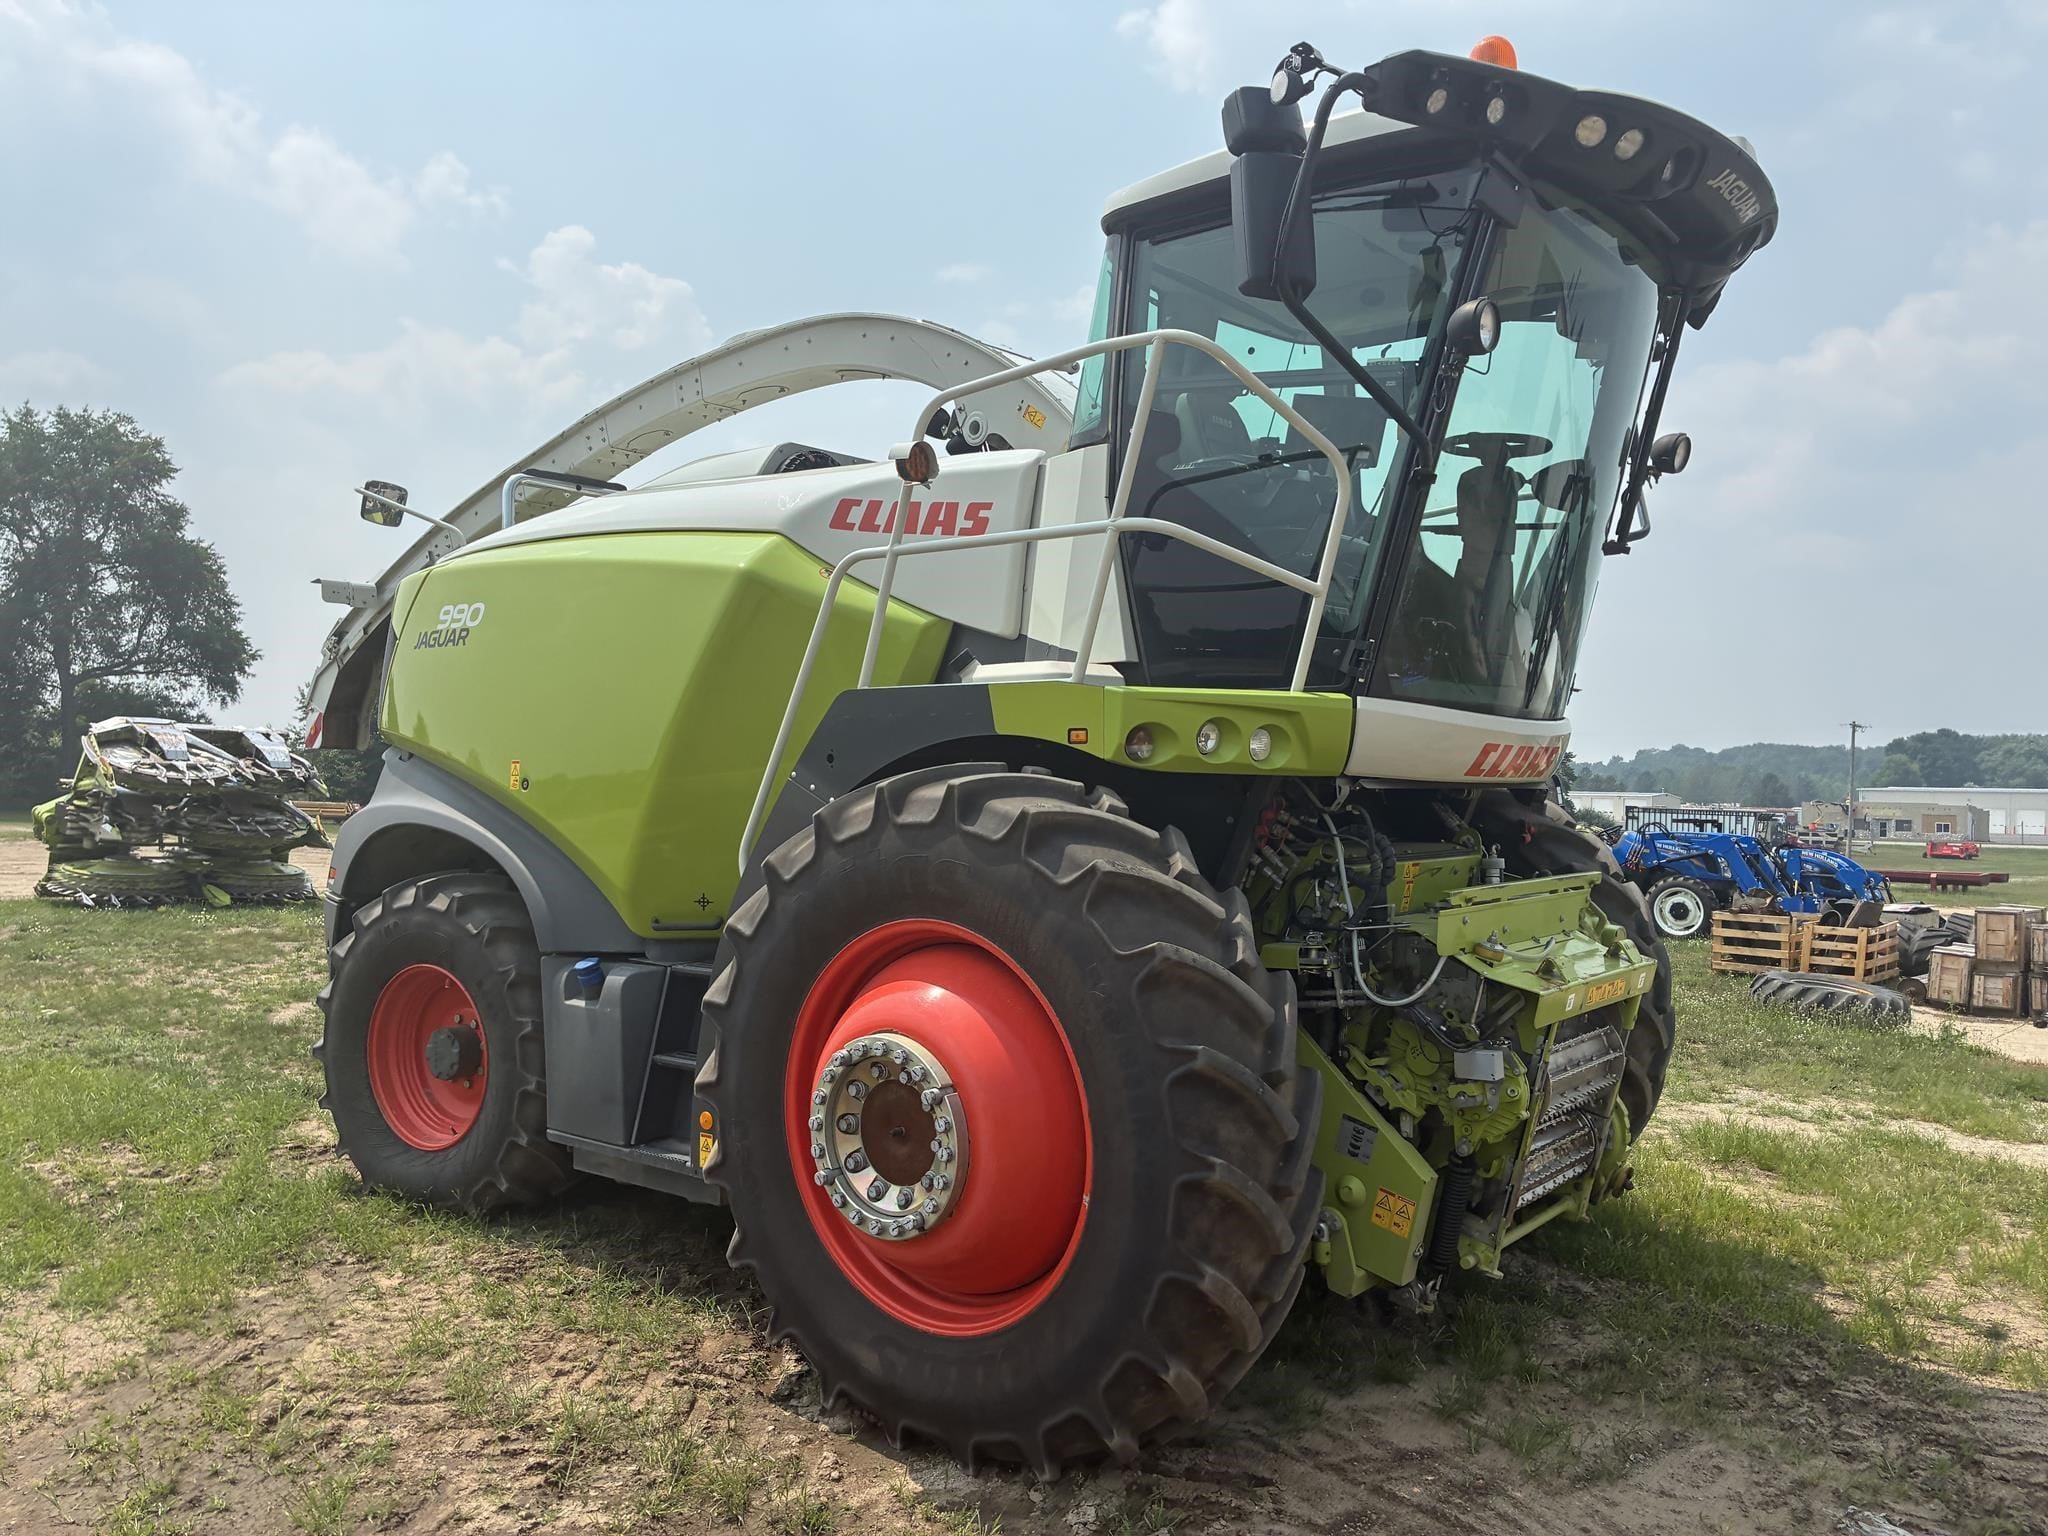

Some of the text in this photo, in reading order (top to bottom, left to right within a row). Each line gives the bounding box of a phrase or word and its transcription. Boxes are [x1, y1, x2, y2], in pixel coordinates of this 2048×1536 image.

[1706, 168, 1760, 223] JAGUAR
[829, 498, 994, 536] CLAAS
[437, 602, 485, 629] 990
[414, 627, 470, 650] JAGUAR
[1463, 742, 1561, 778] CLAAS
[1814, 853, 1839, 868] HOLLAND
